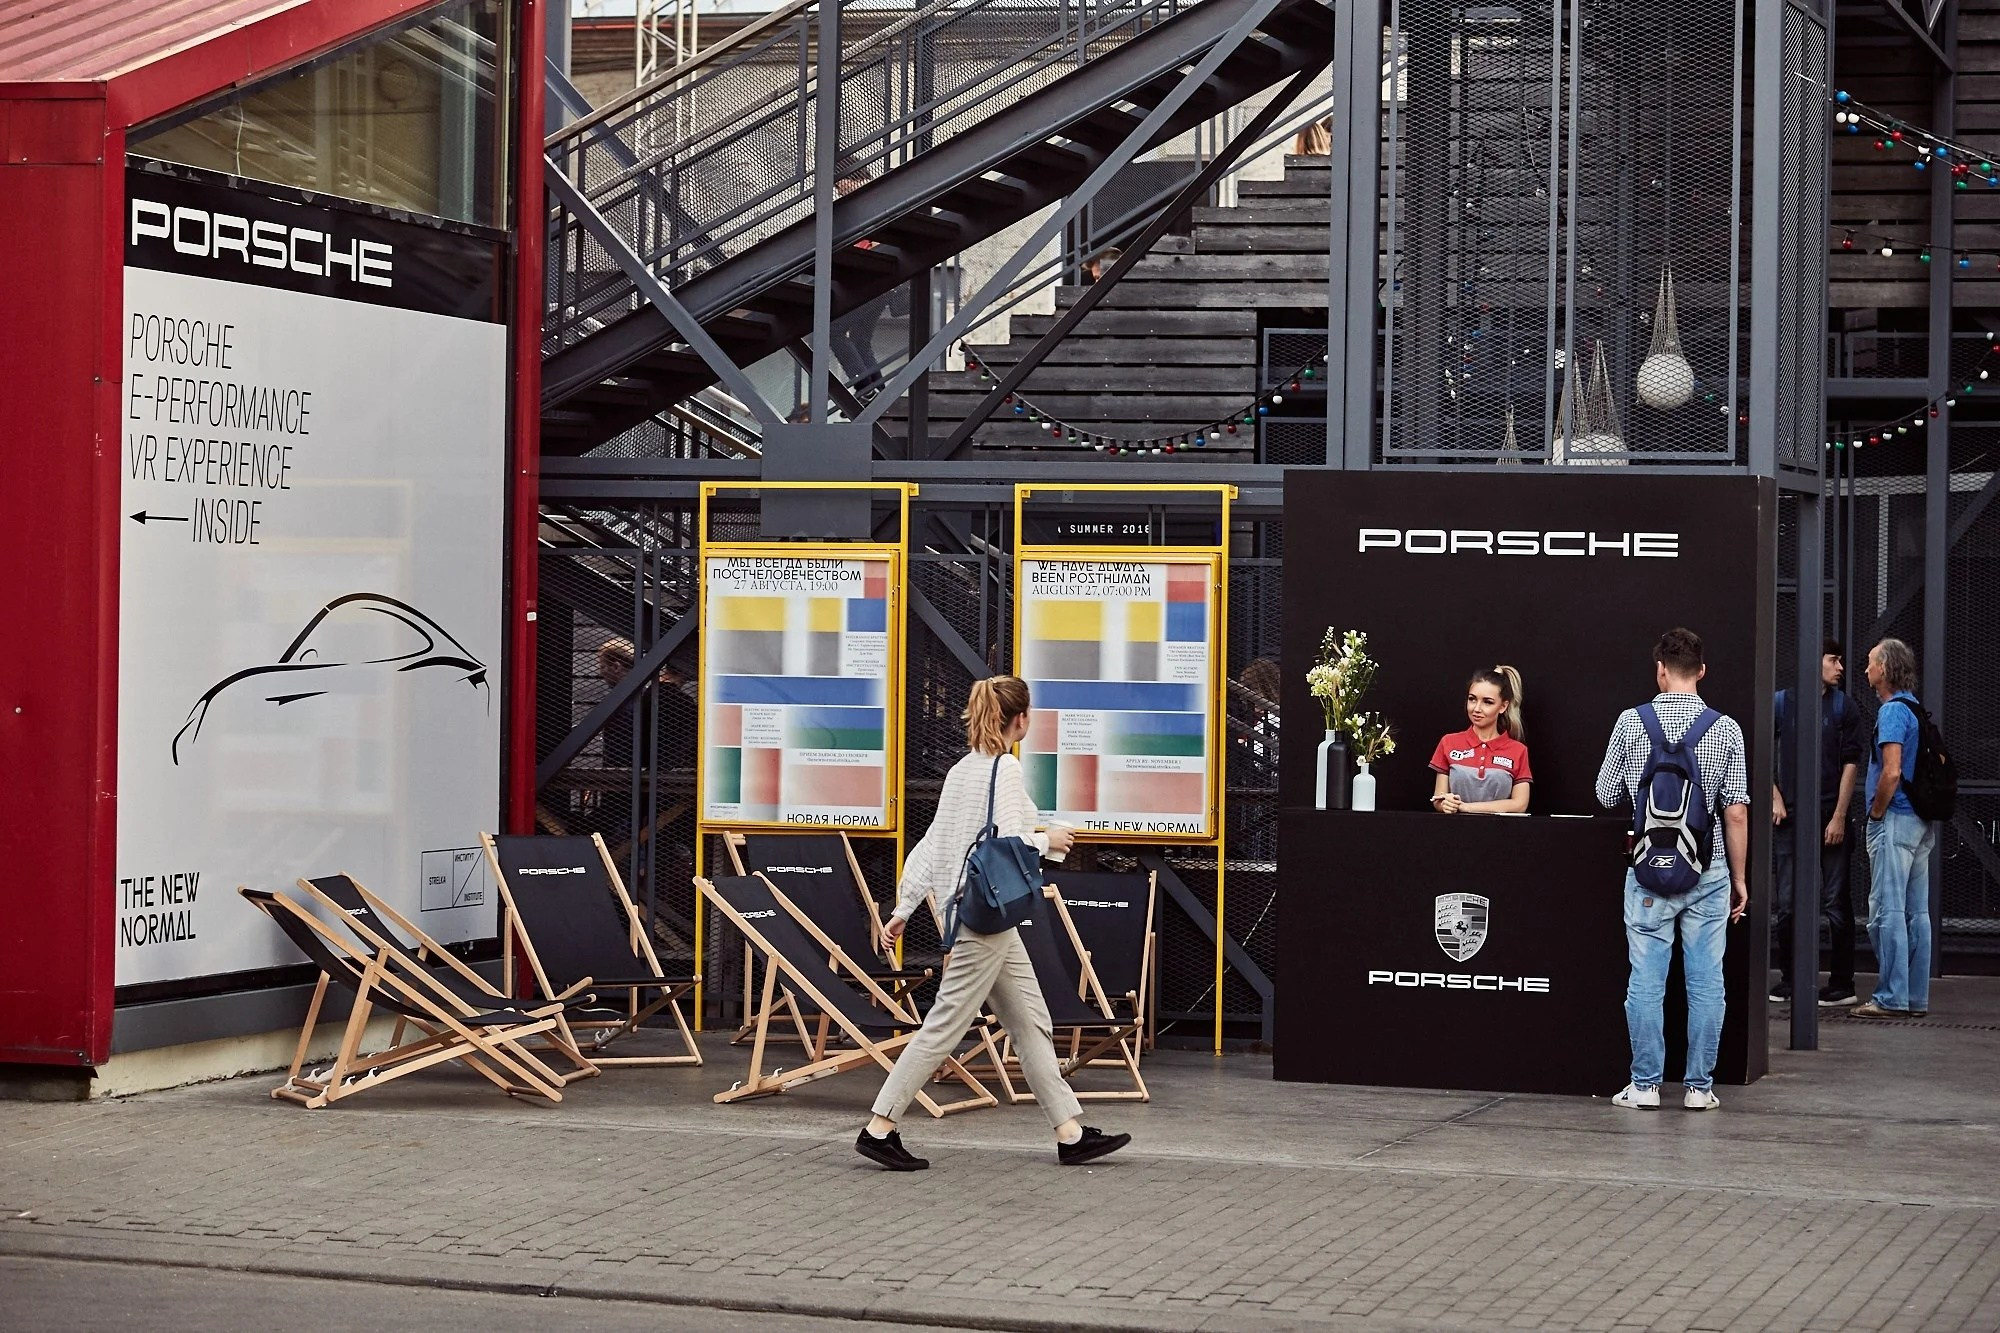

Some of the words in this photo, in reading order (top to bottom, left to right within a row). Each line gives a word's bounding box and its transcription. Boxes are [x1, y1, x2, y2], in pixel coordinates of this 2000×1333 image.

[131, 198, 393, 288] PORSCHE
[130, 312, 235, 370] PORSCHE
[129, 373, 312, 435] E-PERFORMANCE
[129, 433, 157, 482] VR
[164, 436, 294, 490] EXPERIENCE
[192, 497, 263, 545] INSIDE
[1069, 524, 1114, 534] SUMMER
[1358, 528, 1679, 558] PORSCHE
[727, 557, 751, 568] МЫ
[755, 558, 803, 569] ВСЕГДА
[807, 559, 843, 569] БЫЛИ
[1037, 561, 1057, 571] WE
[1062, 561, 1093, 571] HAVE
[1098, 562, 1145, 572] ALWAYS
[713, 568, 862, 581] ПОСТЧЕЛОВЕЧЕСТВОМ
[1032, 572, 1065, 583] BEEN
[1069, 573, 1150, 584] POSTHUMAN
[734, 580, 747, 590] 27
[750, 581, 807, 592] АВГУСТА,
[810, 581, 838, 592] 19:00
[1032, 585, 1083, 595] AUGUST
[1102, 586, 1133, 596] 07:00
[1134, 586, 1151, 597] PM
[787, 813, 829, 825] НОВАЯ
[833, 814, 879, 826] НОРМА
[1084, 820, 1110, 831] THE
[1114, 821, 1143, 832] NEW
[1147, 822, 1203, 834] NORMAL
[518, 866, 586, 875] PORSCHE
[766, 866, 833, 874] PORSCHE
[120, 876, 155, 909] THE
[161, 871, 200, 905] NEW
[120, 909, 196, 948] NORMAL
[1368, 970, 1550, 993] PORSCHE
